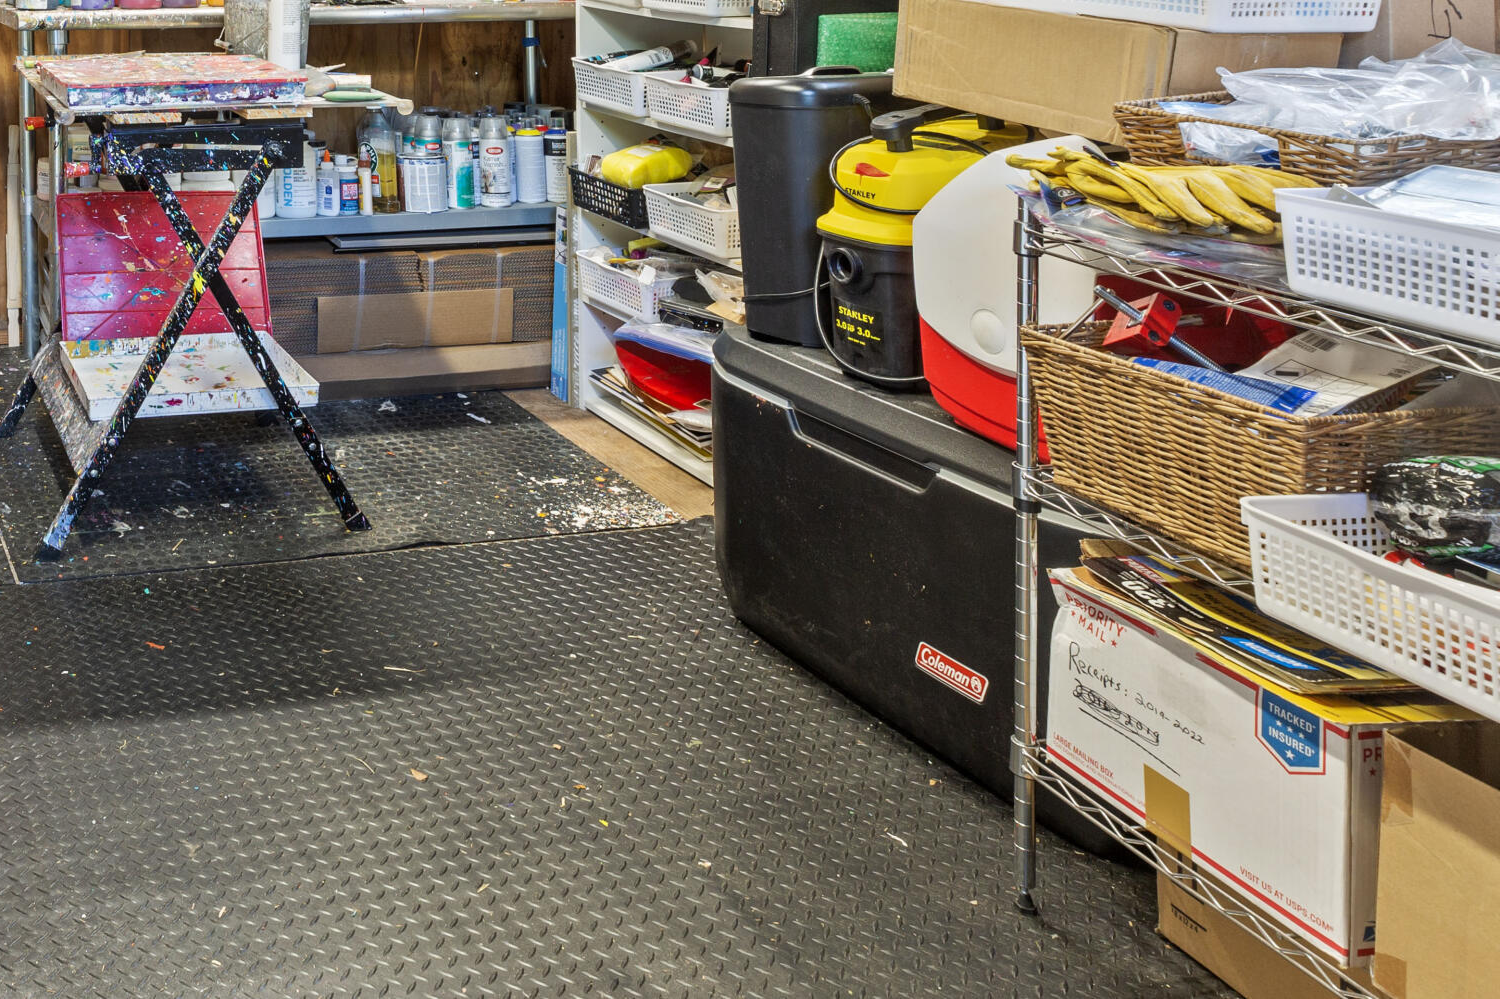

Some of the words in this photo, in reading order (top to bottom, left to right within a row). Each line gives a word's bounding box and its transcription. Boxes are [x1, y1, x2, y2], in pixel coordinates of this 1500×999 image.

[283, 167, 293, 208] OLDEN
[838, 305, 875, 325] STANLEY
[857, 326, 871, 338] 3.0
[1078, 615, 1107, 643] MAIL
[921, 647, 970, 687] Coleman
[1052, 732, 1072, 750] LARGE
[1073, 745, 1100, 769] MAILING
[1099, 764, 1114, 779] BOX
[1240, 865, 1260, 886] VISIT
[1261, 880, 1273, 894] US
[1273, 888, 1285, 902] AT
